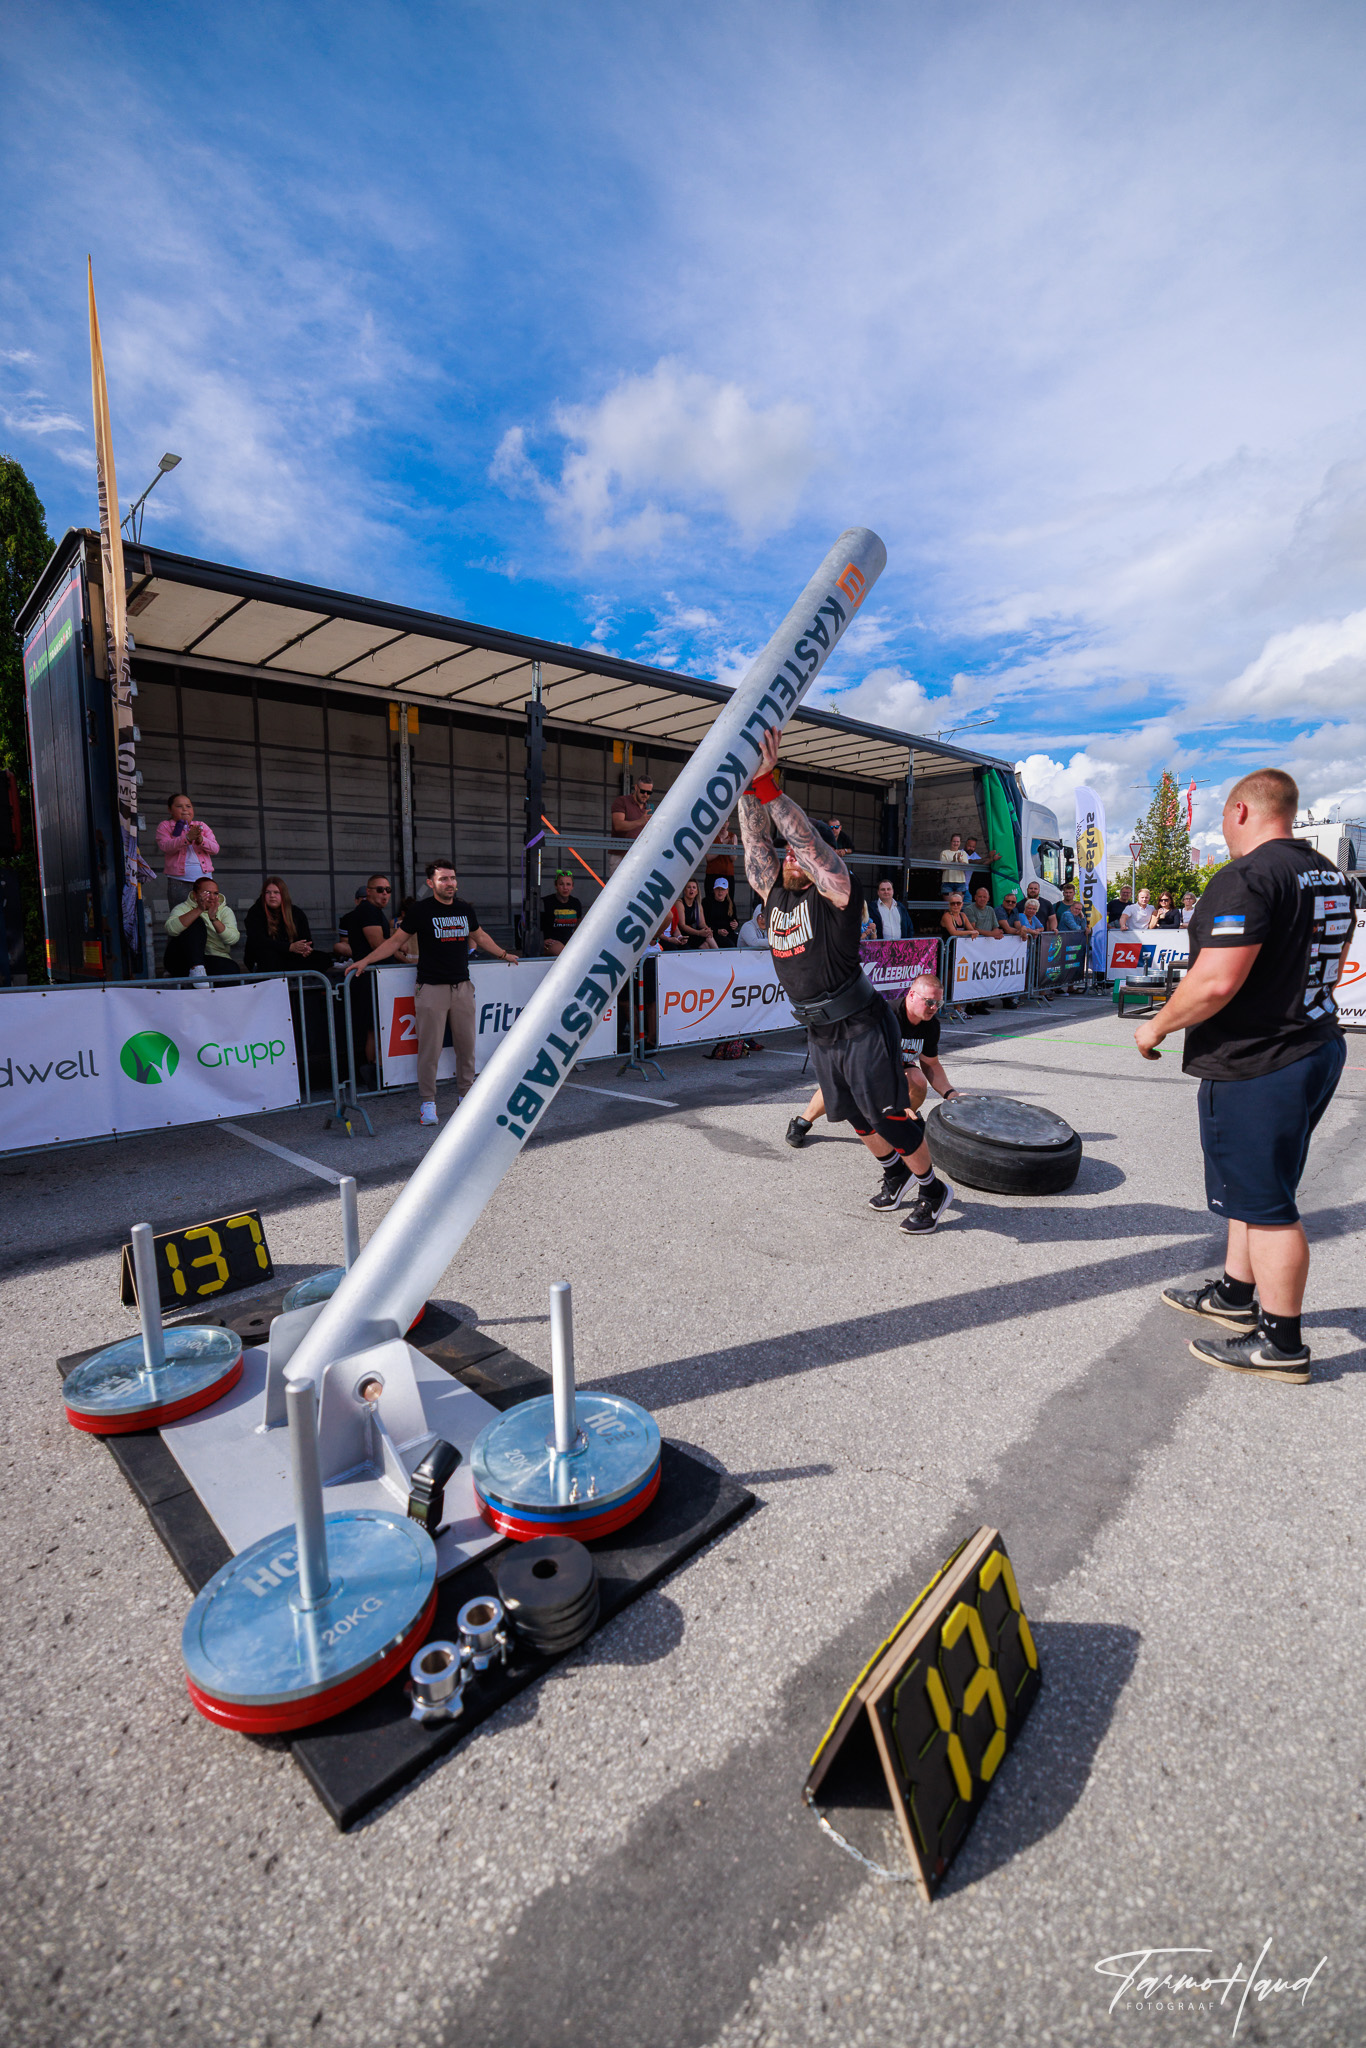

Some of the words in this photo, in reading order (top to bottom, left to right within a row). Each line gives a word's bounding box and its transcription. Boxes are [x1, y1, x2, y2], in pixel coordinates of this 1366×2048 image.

[739, 595, 846, 757] KASTELLI
[662, 752, 748, 866] KODU,
[616, 869, 676, 953] MIS
[971, 956, 1025, 981] KASTELLI
[1115, 950, 1136, 963] 24
[663, 988, 715, 1016] POP
[197, 1039, 286, 1069] Grupp
[496, 949, 627, 1141] KESTAB!
[164, 1214, 269, 1297] 137
[504, 1449, 535, 1473] 20K
[321, 1596, 384, 1647] 20KG
[925, 1549, 1038, 1803] 137
